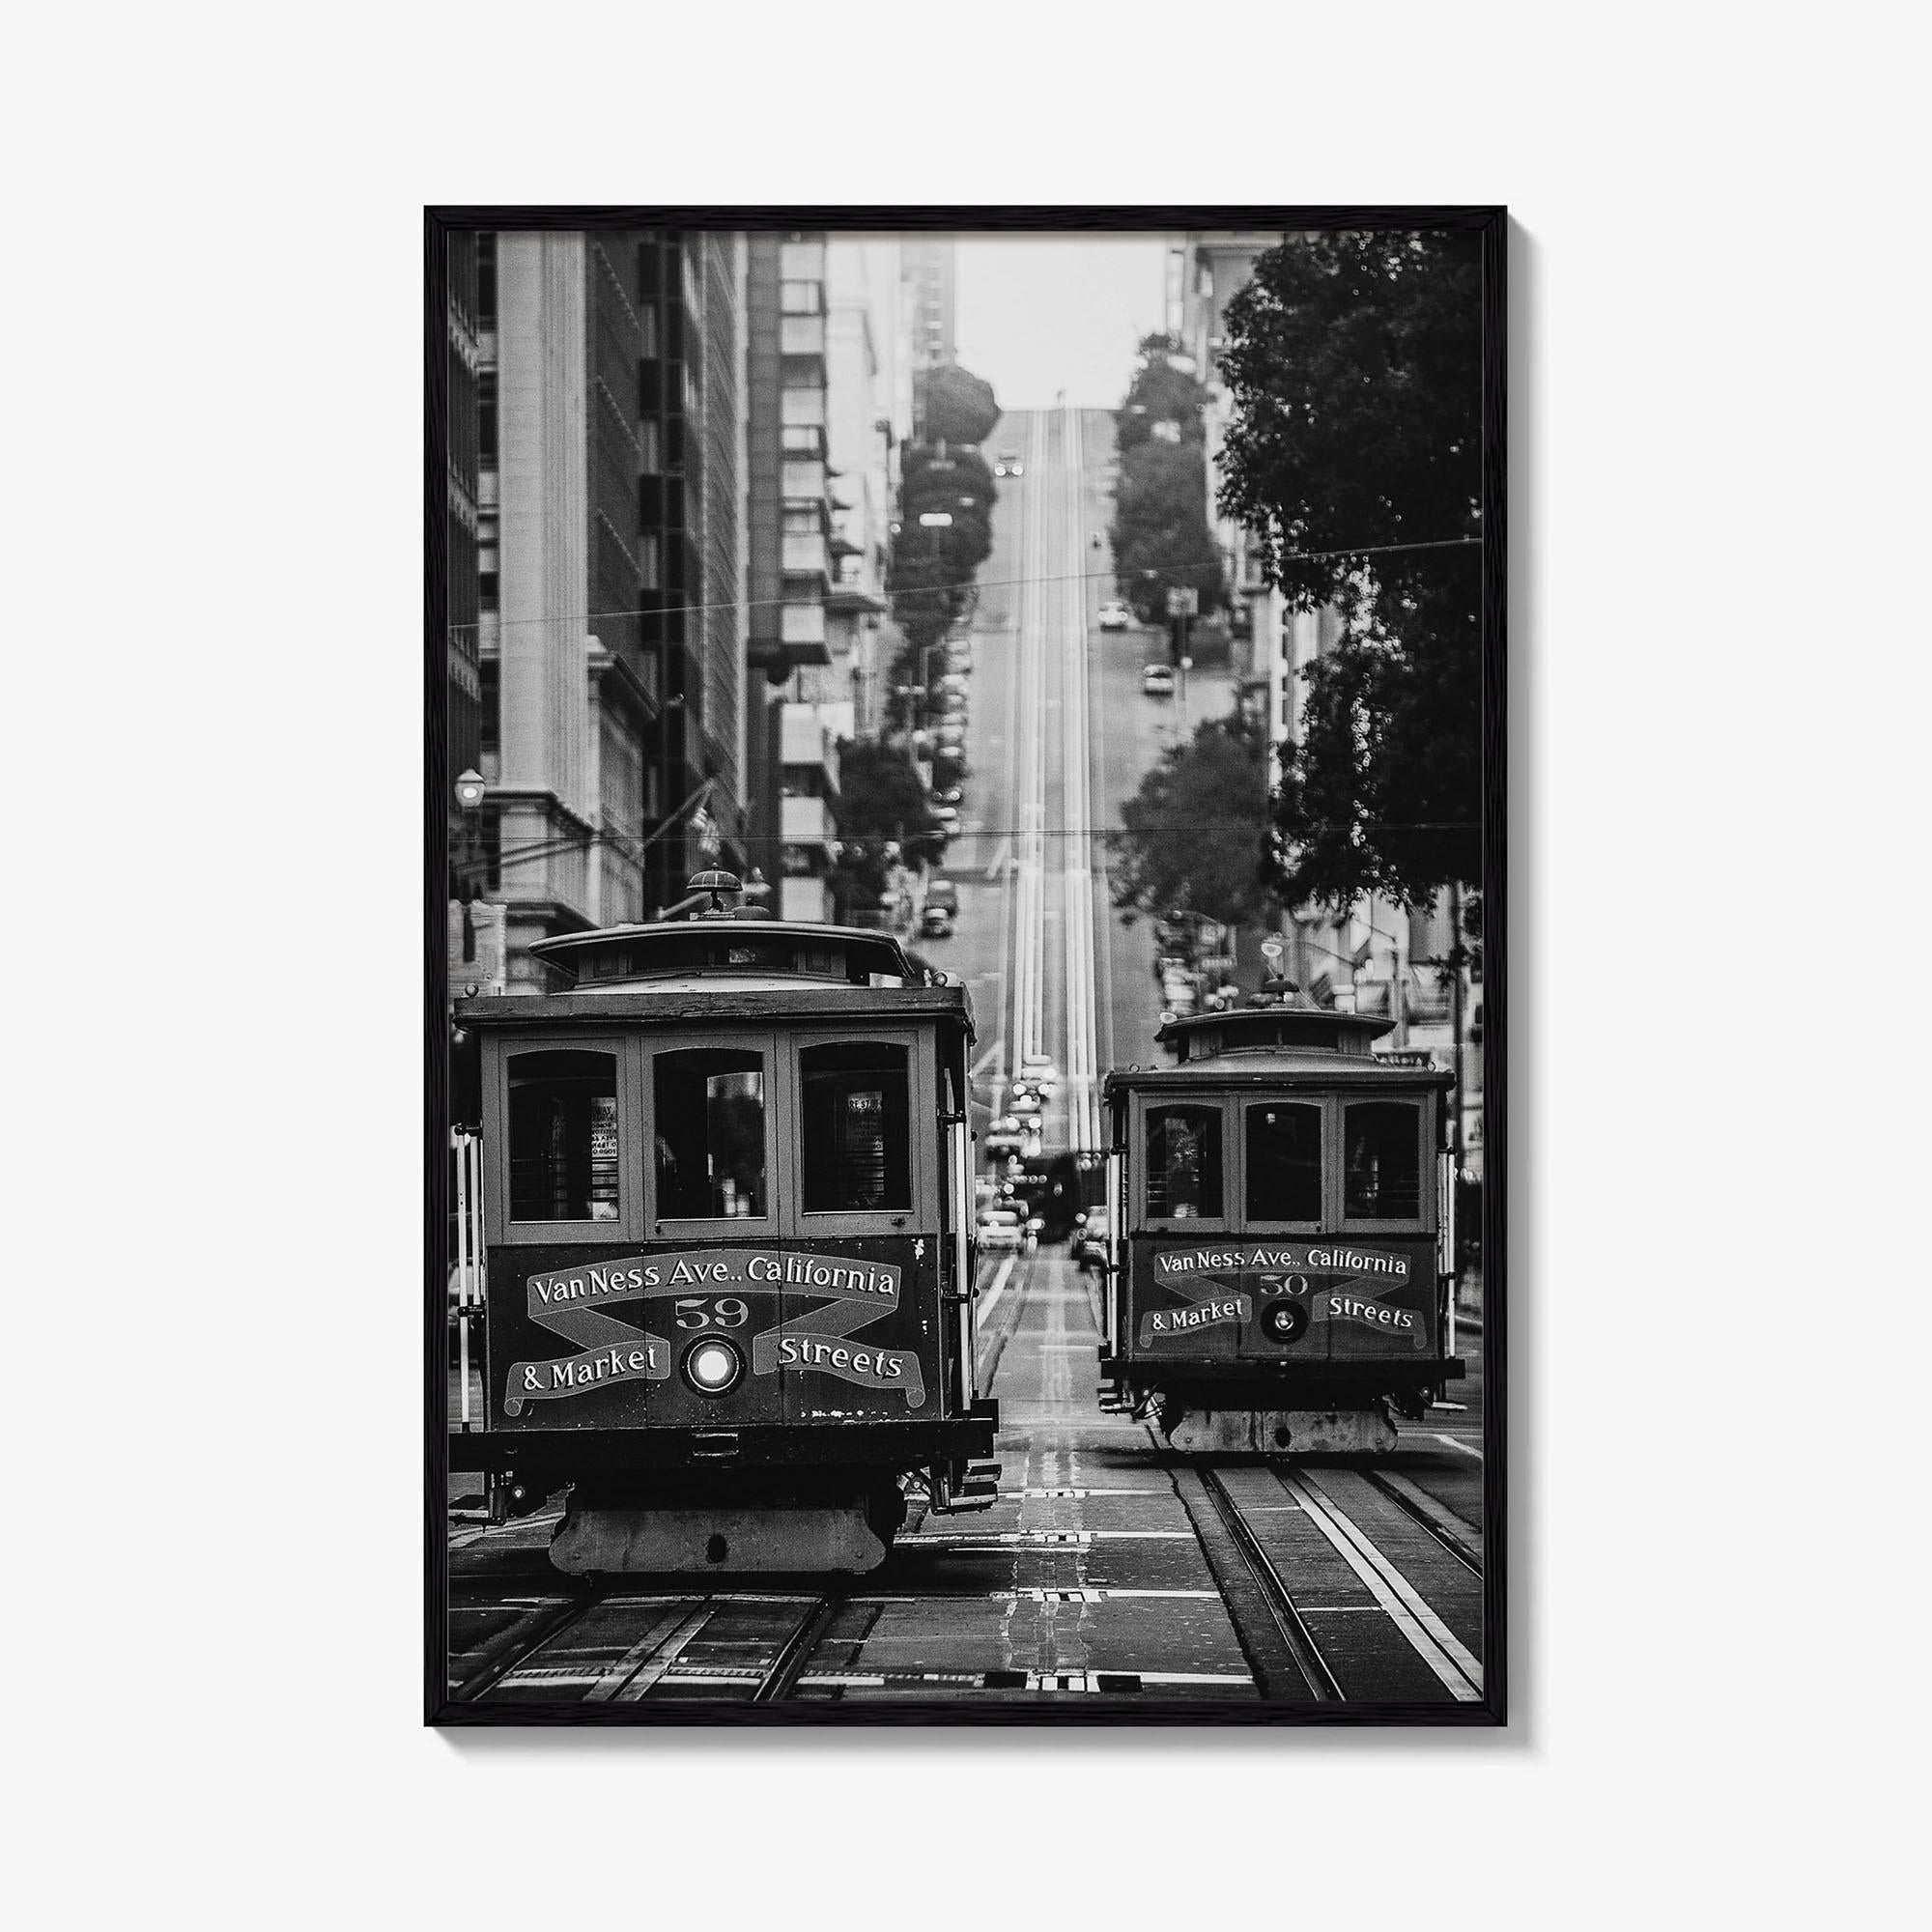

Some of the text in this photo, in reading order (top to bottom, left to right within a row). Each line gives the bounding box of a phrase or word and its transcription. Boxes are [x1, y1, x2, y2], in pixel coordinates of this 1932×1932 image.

[1159, 1255, 1195, 1273] Van
[1197, 1251, 1245, 1268] Ness
[1307, 1249, 1406, 1275] California
[534, 1276, 583, 1304] Van
[587, 1263, 660, 1294] Ness
[748, 1254, 895, 1295] California
[1260, 1274, 1308, 1295] 50
[674, 1297, 749, 1329] 59
[1152, 1296, 1413, 1330] & Market Streets
[524, 1338, 903, 1390] & Market Streets
